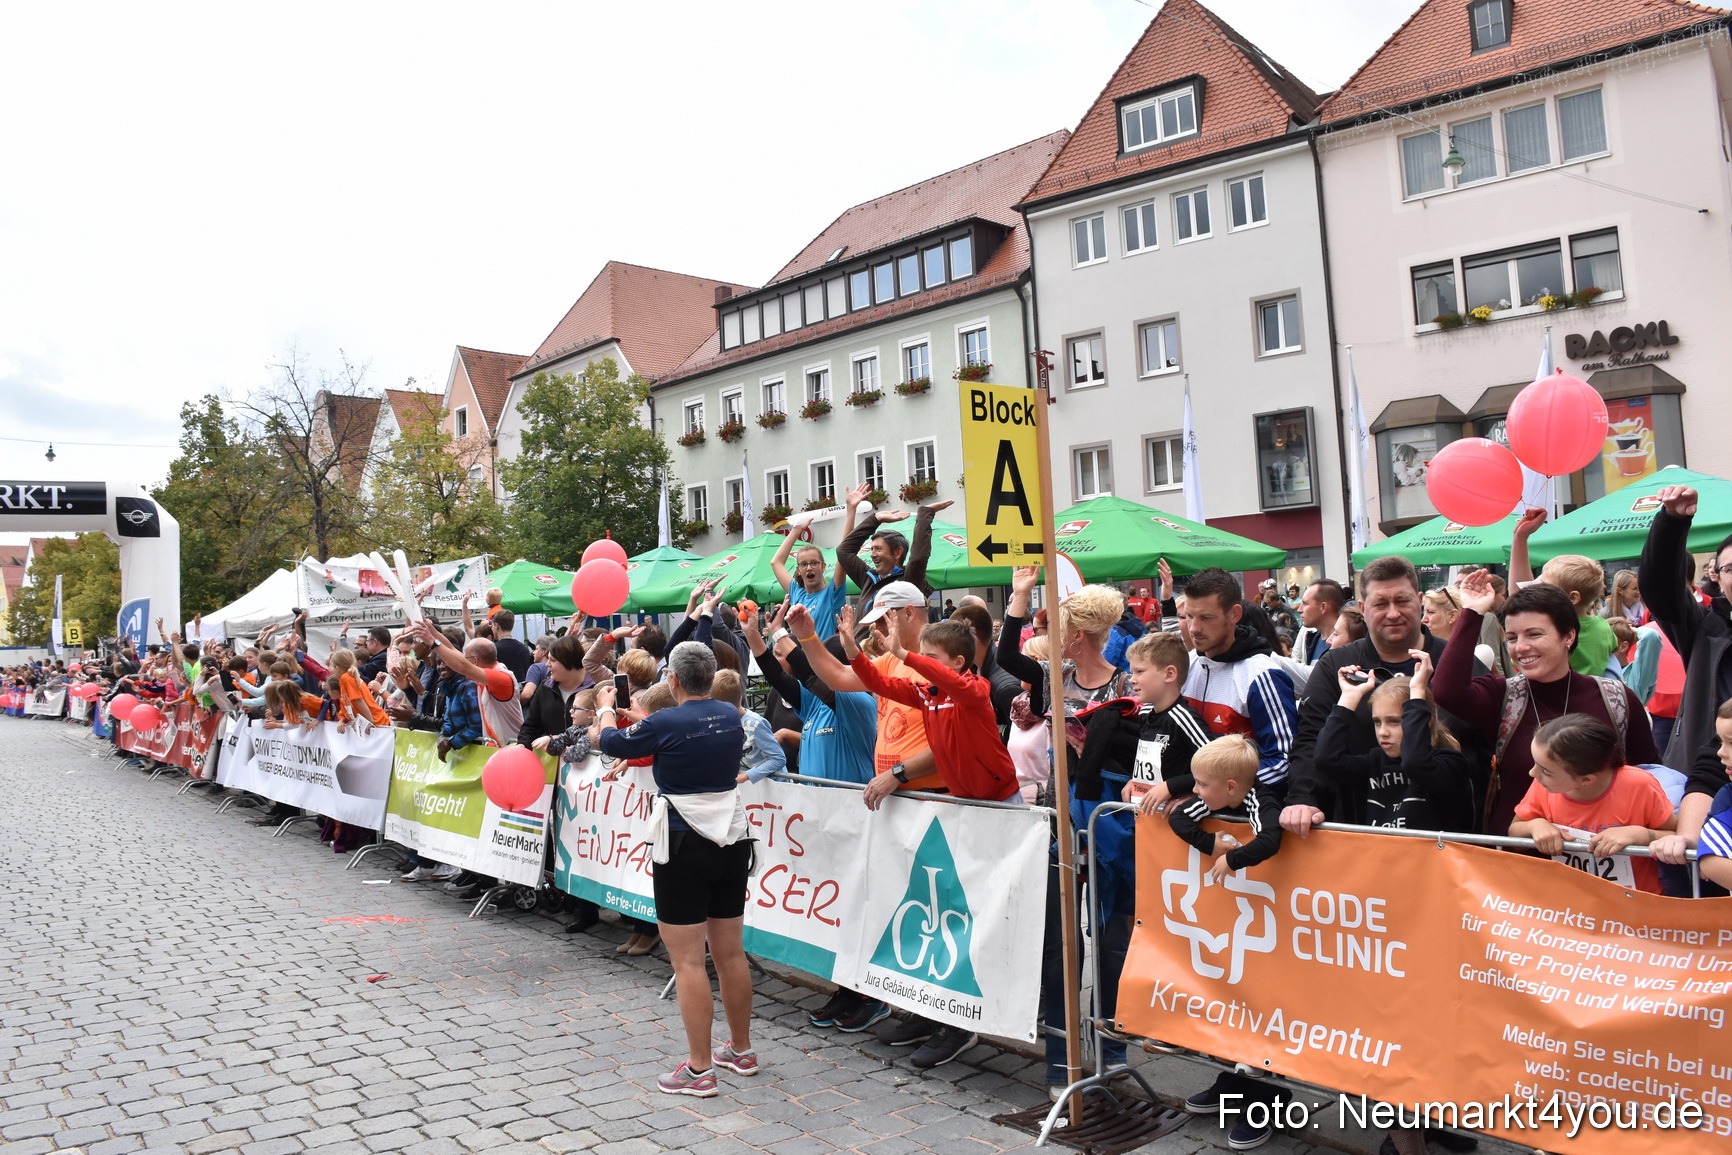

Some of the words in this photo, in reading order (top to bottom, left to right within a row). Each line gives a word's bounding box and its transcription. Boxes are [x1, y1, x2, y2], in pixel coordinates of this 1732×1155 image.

[1565, 320, 1680, 360] RACKL
[1582, 361, 1605, 371] am
[1607, 350, 1670, 368] Rathaus
[1039, 361, 1048, 389] Acha
[971, 389, 1036, 426] Block
[985, 439, 1034, 526] A
[1579, 521, 1652, 534] Lammsb
[1599, 514, 1655, 525] Neumar
[1405, 539, 1482, 548] Lammsbräu
[70, 628, 79, 640] B
[1133, 759, 1155, 781] 013
[1290, 886, 1388, 933] CODE
[1481, 893, 1596, 931] Neumarkts
[1601, 919, 1711, 946] moderner
[1292, 925, 1408, 978] CLINIC
[1461, 912, 1488, 933] für
[1490, 919, 1522, 940] die
[1525, 927, 1644, 962] Konzeption
[1648, 952, 1694, 970] und
[1485, 943, 1533, 968] Ihrer
[1536, 955, 1628, 987] Projekte
[1633, 975, 1677, 992] was
[864, 970, 880, 988] Jura
[882, 976, 917, 1001] Gebäude
[948, 998, 982, 1021] GmbH
[1459, 962, 1571, 1004] Grafikdesign
[1575, 992, 1618, 1010] und
[1622, 995, 1726, 1029] Werbung
[1149, 979, 1402, 1067] KreativAgentur
[1502, 1023, 1568, 1056] Melden
[1573, 1040, 1607, 1062] Sie
[1612, 1048, 1660, 1070] sich
[1667, 1052, 1704, 1076] bei
[1513, 1080, 1546, 1103] tel:
[1524, 1059, 1571, 1082] web:
[1577, 1070, 1732, 1109] codeclinic.de
